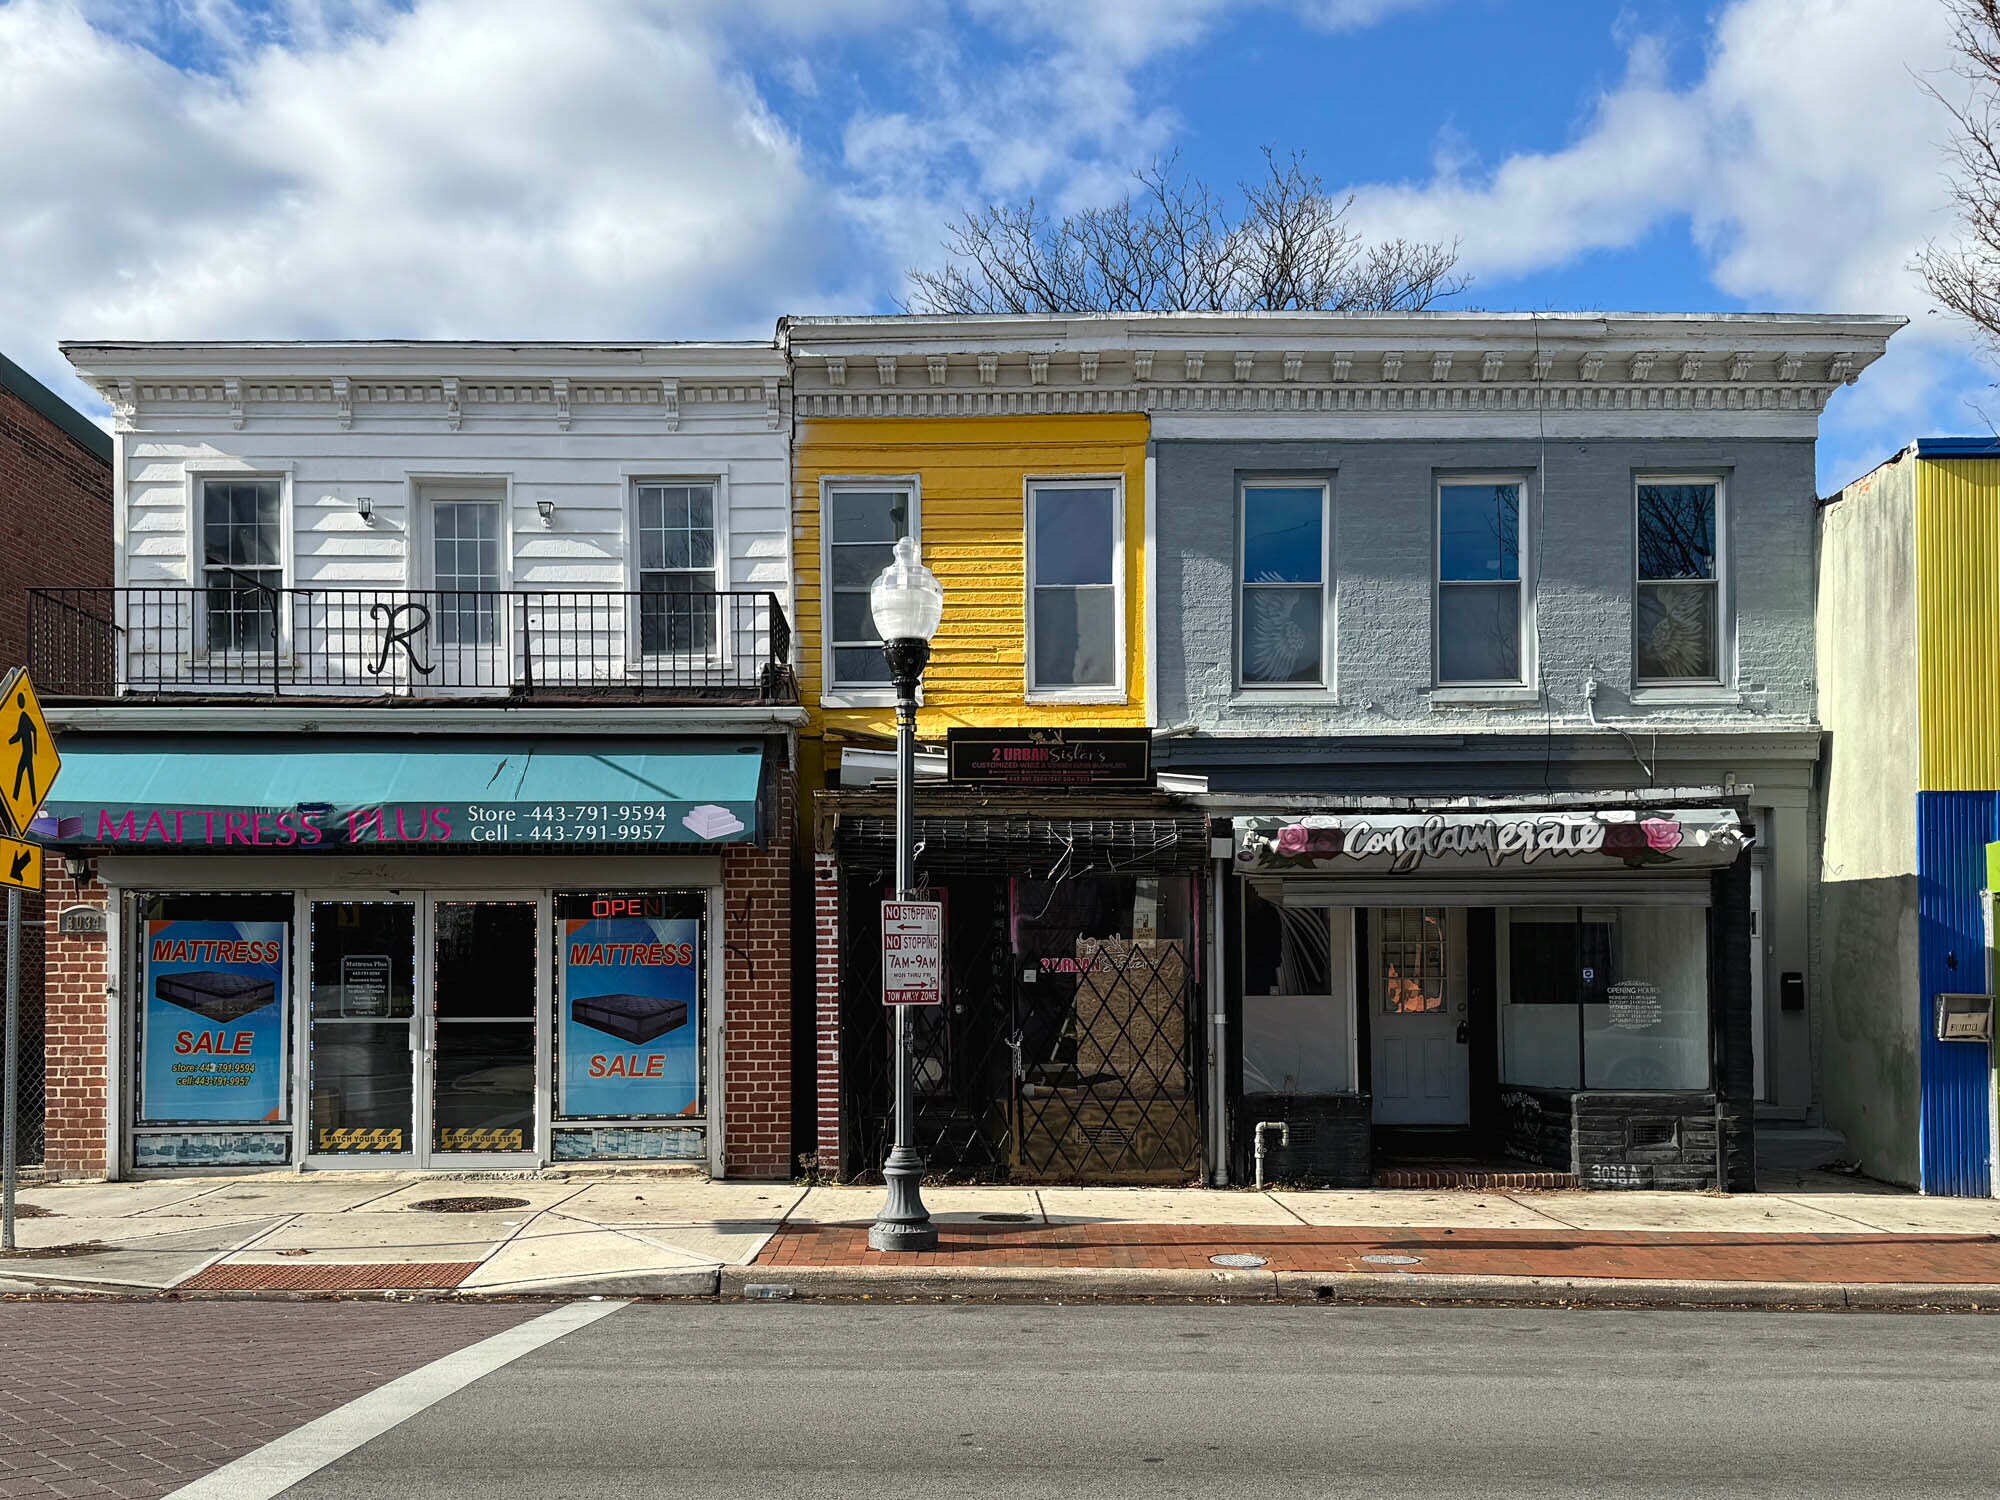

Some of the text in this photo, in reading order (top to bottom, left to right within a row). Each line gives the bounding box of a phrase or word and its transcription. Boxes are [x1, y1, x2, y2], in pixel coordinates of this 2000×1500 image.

[367, 603, 436, 675] R
[992, 748, 1000, 761] 2
[1004, 748, 1049, 761] URBAN
[468, 805, 516, 822] Store
[96, 806, 452, 846] MATTRESS PLUS
[470, 824, 508, 842] Cell
[529, 824, 665, 841] 443-791-9957
[1342, 814, 1606, 874] Conglamerate
[592, 898, 660, 917] OPEN
[886, 906, 937, 920] NO STOPPING
[152, 939, 280, 963] MATTRESS
[886, 936, 938, 949] NO STOPPING
[569, 943, 693, 966] MATTRESS
[888, 954, 937, 969] 7AM-9AM
[887, 991, 937, 1001] TOW AWAY ZONE
[174, 1030, 255, 1056] SALE
[172, 1063, 256, 1073] store: 443-791-9594
[588, 1054, 666, 1079] SALE
